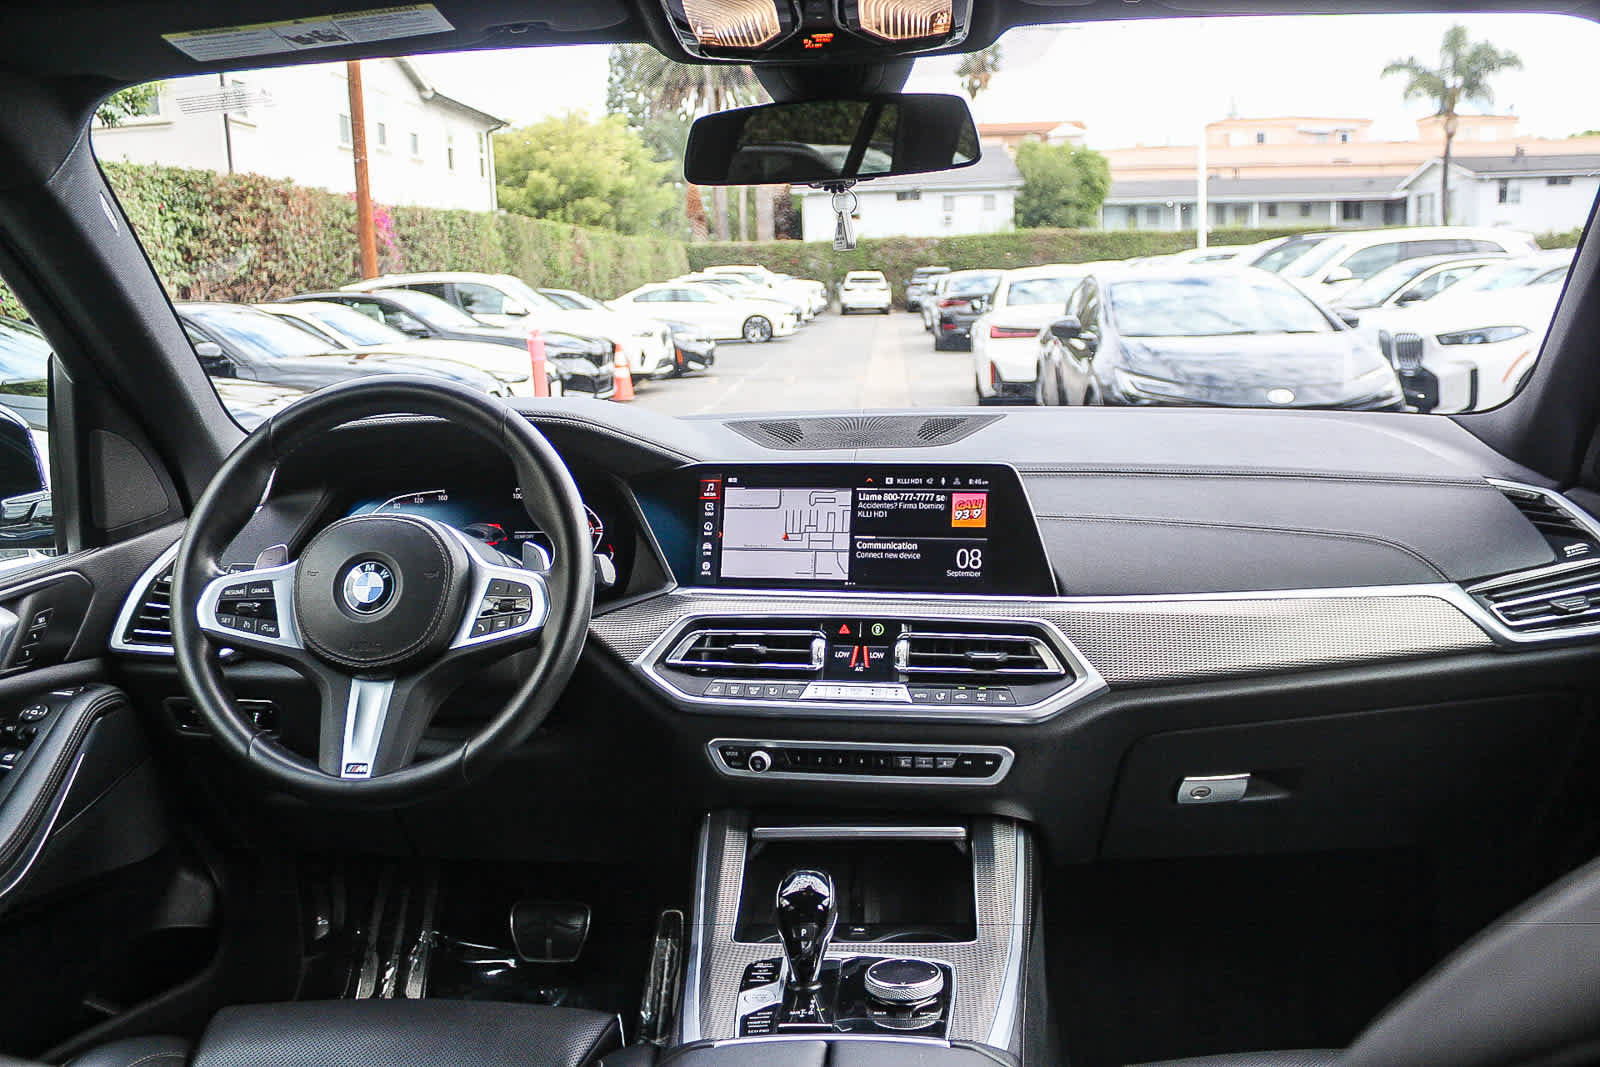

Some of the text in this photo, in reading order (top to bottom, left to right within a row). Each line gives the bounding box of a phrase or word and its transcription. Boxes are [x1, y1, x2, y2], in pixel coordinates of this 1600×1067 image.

[858, 492, 882, 501] Llame
[883, 493, 935, 502] 800-777-7777
[918, 503, 945, 511] Doming
[954, 508, 982, 520] 93.9
[856, 541, 918, 550] Communication
[856, 551, 884, 559] Connect
[899, 552, 921, 560] device
[956, 548, 983, 570] 08
[946, 569, 981, 578] September
